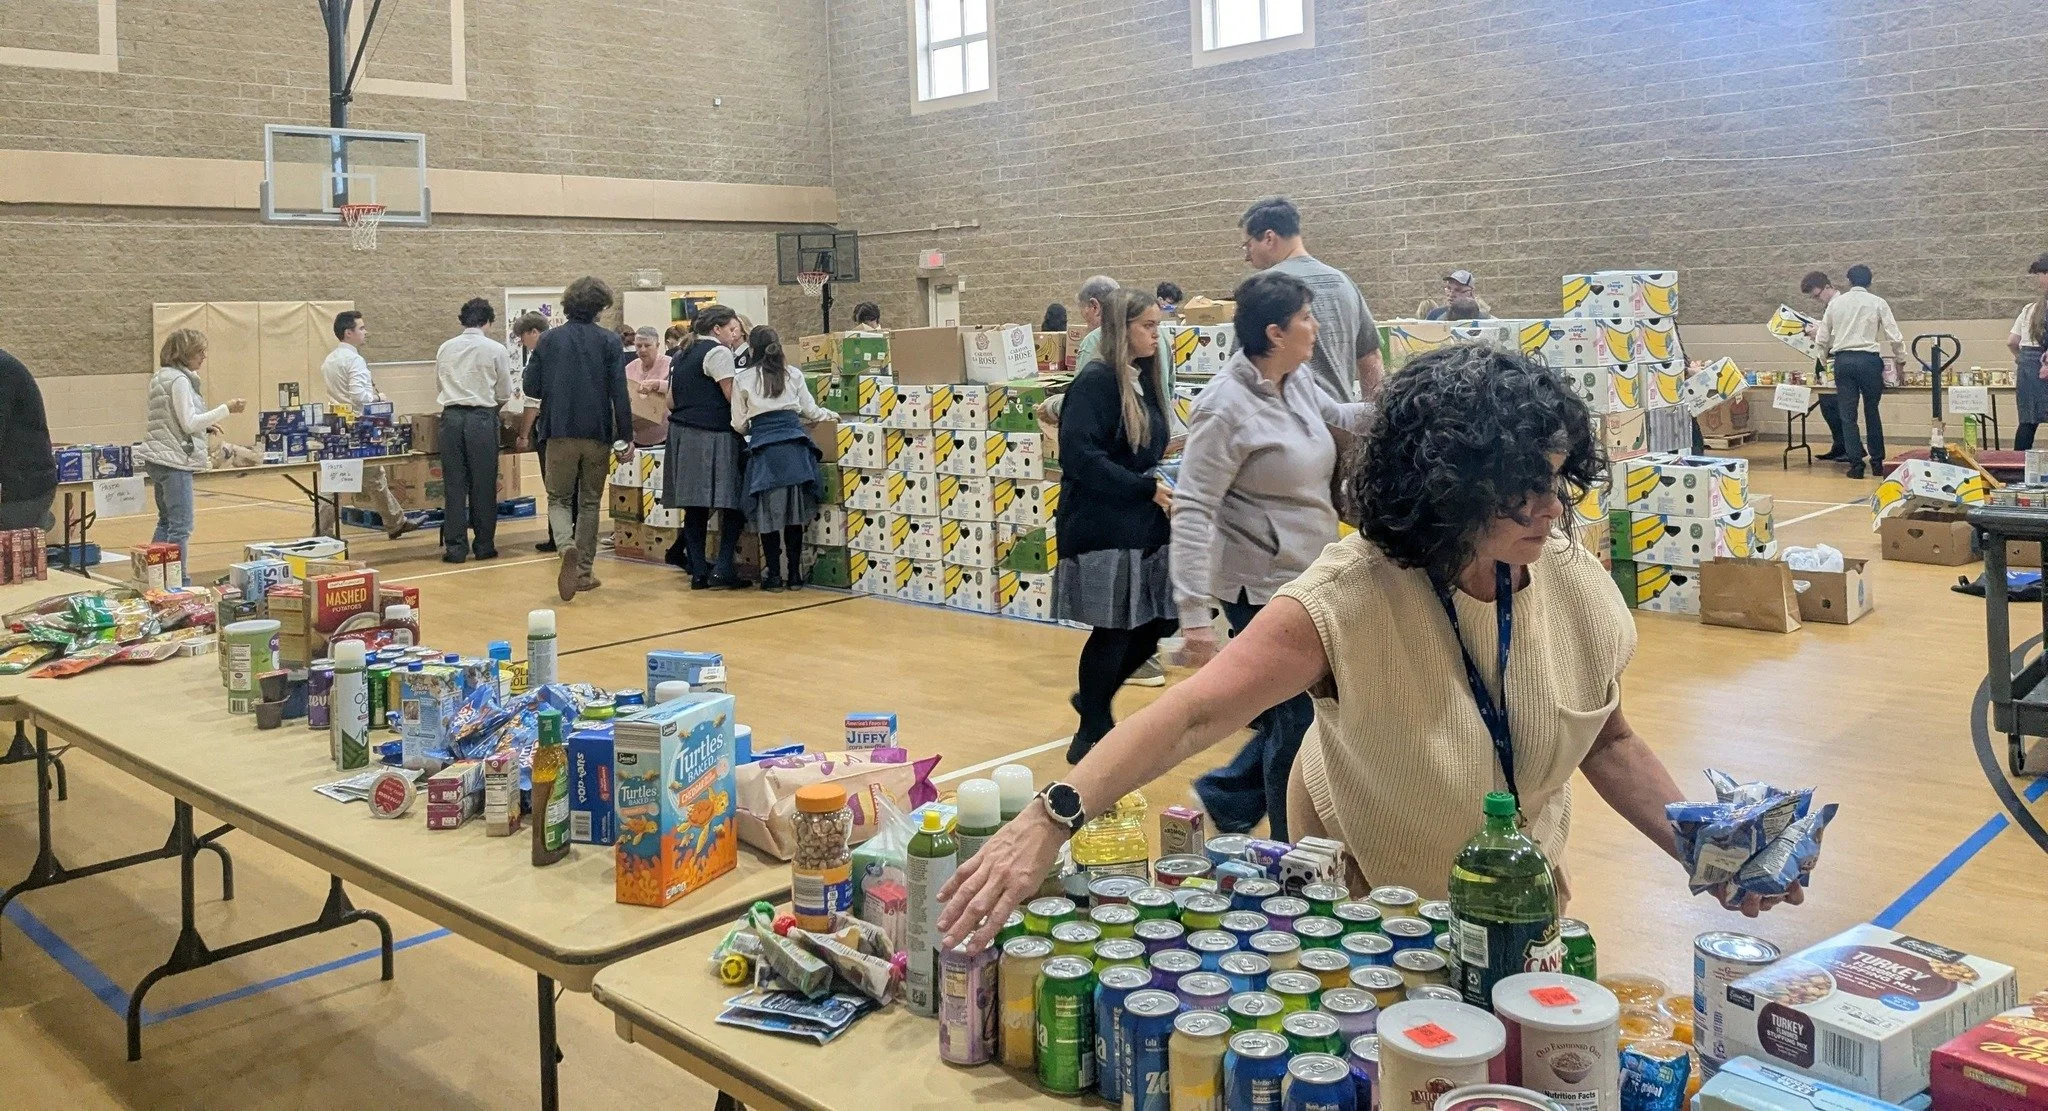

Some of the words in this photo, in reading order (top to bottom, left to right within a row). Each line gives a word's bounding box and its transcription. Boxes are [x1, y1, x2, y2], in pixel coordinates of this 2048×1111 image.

[978, 357, 997, 365] ROSE
[1014, 350, 1032, 361] ROSE
[326, 588, 367, 607] MASHED
[332, 604, 362, 613] POTATOES
[846, 731, 887, 743] JIFFY
[681, 733, 724, 780] Turtles
[688, 756, 714, 783] BAKED
[620, 785, 657, 802] Turtles
[628, 798, 649, 806] BAKED
[1852, 951, 1931, 981] TURKEY
[1893, 980, 1921, 993] MIX
[1771, 1013, 1804, 1035] TURKEY
[1796, 1041, 1808, 1050] MIX
[1536, 1047, 1551, 1058] OLD
[1544, 1090, 1577, 1100] Nutrition
[1578, 1091, 1596, 1100] Facts
